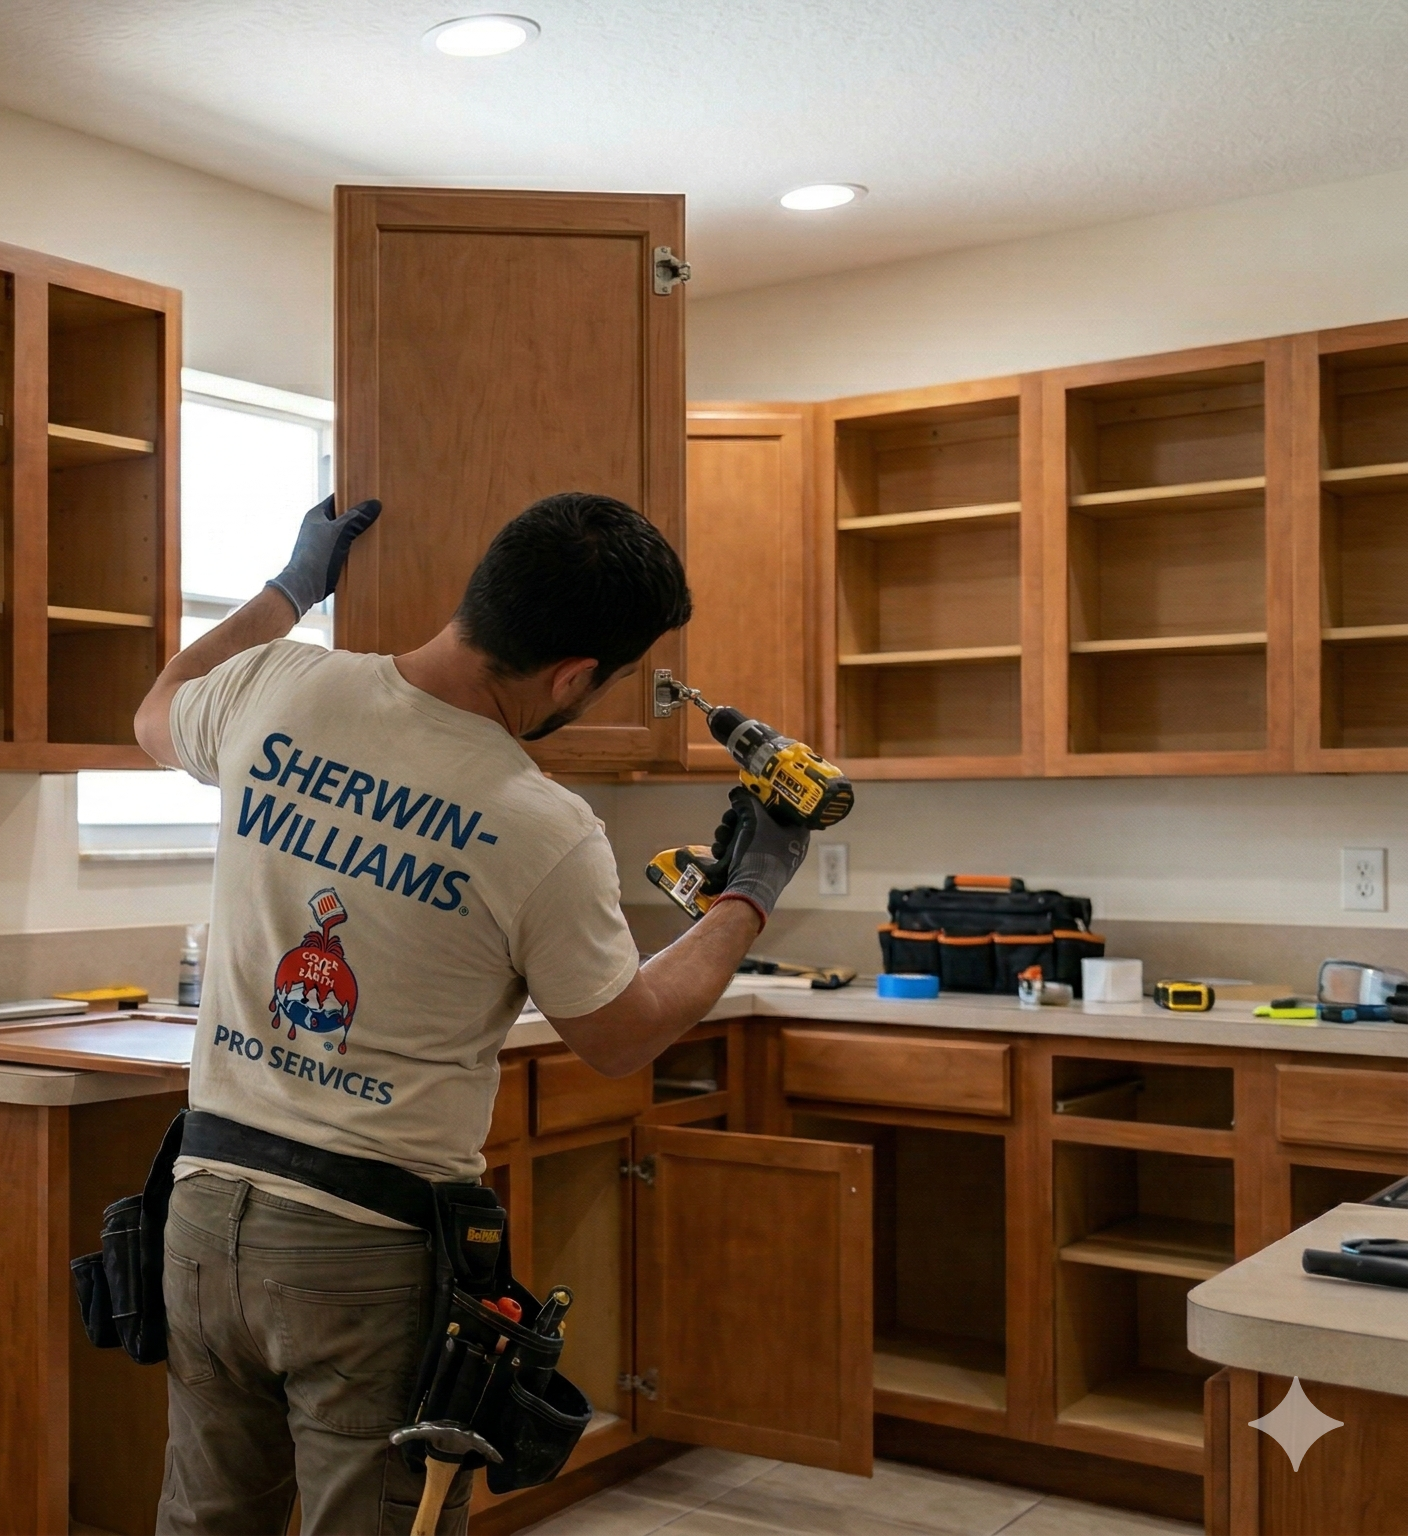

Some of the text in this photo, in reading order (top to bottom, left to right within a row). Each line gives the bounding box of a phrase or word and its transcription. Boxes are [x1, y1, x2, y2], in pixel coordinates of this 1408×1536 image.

[248, 732, 499, 850] SHERWIN-
[213, 1024, 395, 1105] PRO SERVICES
